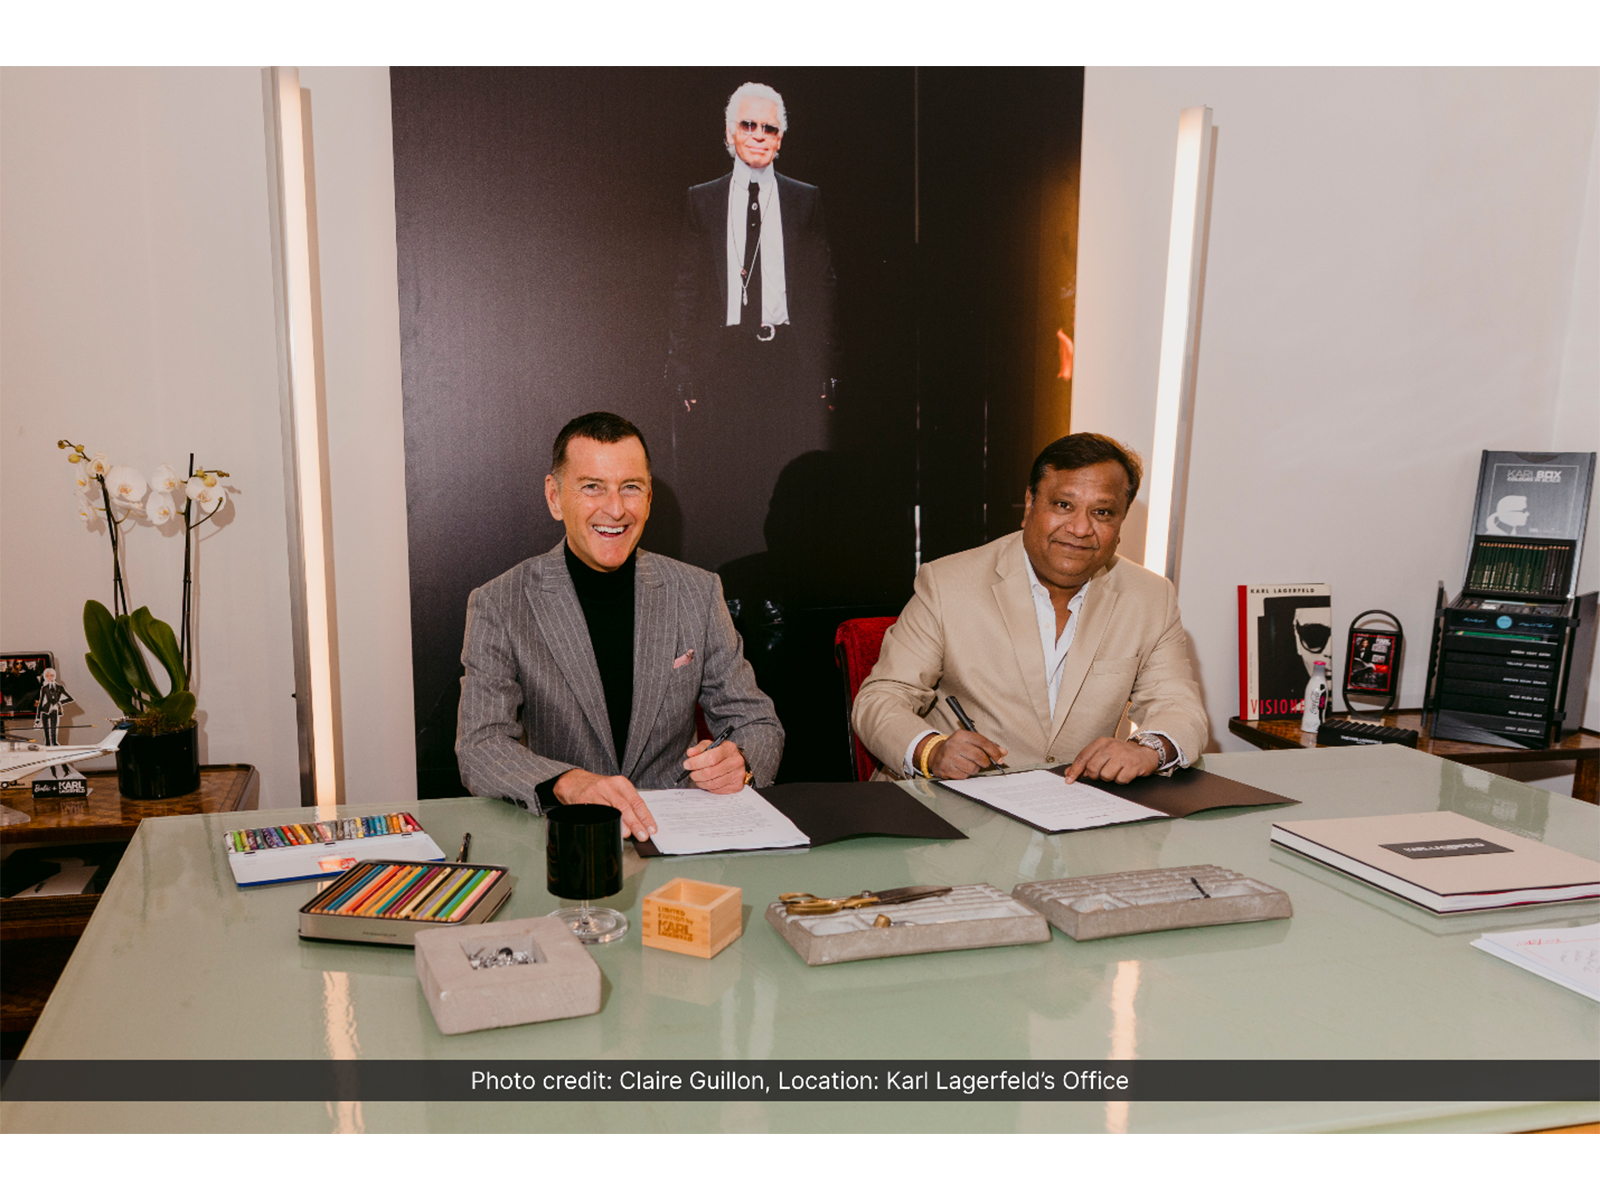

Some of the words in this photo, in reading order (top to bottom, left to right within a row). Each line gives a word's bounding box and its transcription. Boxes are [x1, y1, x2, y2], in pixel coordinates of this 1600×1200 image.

[1537, 470, 1562, 479] BOX
[58, 781, 85, 789] KARL
[658, 920, 688, 936] KARL
